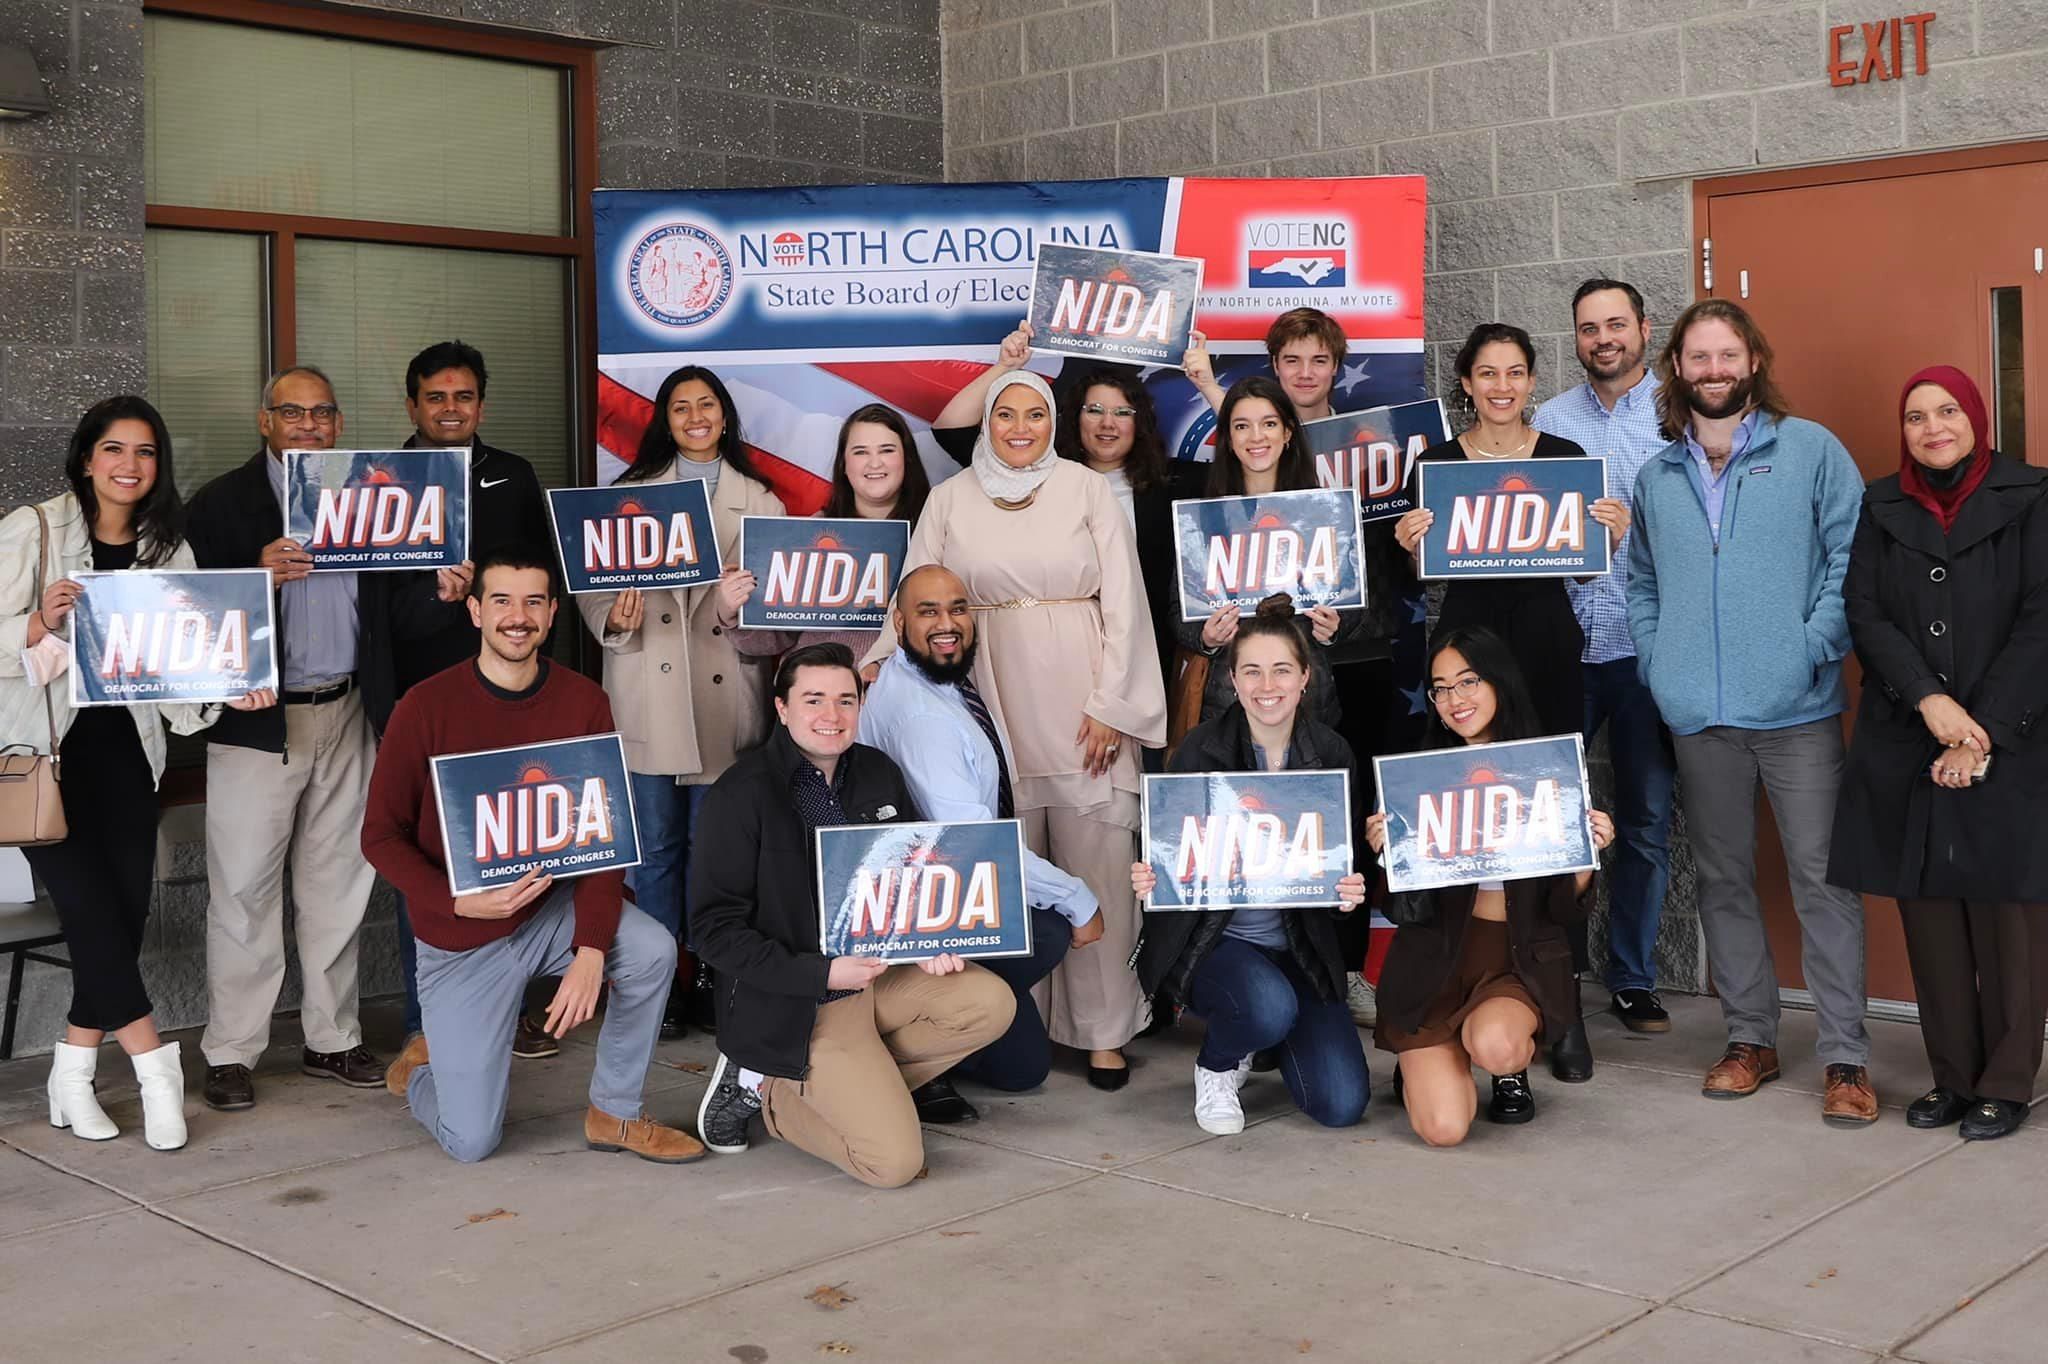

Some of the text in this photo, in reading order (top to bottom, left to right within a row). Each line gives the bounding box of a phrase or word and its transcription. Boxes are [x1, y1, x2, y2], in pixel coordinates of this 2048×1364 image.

[1827, 12, 1936, 87] EXIT
[665, 226, 697, 236] STATE
[704, 235, 729, 264] NORTH
[773, 244, 805, 255] VOTE
[767, 283, 835, 307] State
[846, 279, 928, 305] Board
[936, 279, 966, 309] of
[1050, 277, 1175, 344] NIDA
[1197, 295, 1398, 307] MY NORTH CAROLINA. MY VOTE.
[1050, 336, 1168, 358] DEMOCRAT FOR CONGRESS
[1315, 433, 1429, 498] NIDA
[312, 485, 444, 548] NIDA
[1372, 502, 1390, 511] FOR
[1446, 491, 1584, 554] NIDA
[314, 551, 444, 563] DEMOCRAT FOR CONGRESS
[583, 512, 699, 571] NIDA
[590, 569, 700, 584] DEMOCRAT FOR CONGRESS
[1206, 526, 1340, 595] NIDA
[1449, 557, 1584, 568] DEMOCRAT FOR CONGRESS
[764, 551, 889, 608] NIDA
[766, 611, 817, 620] DEMOCRAT
[819, 612, 838, 621] FOR
[102, 609, 248, 679] NIDA
[104, 680, 249, 694] DEMOCRAT FOR CONGRESS
[475, 777, 614, 863] NIDA
[1416, 778, 1565, 859] NIDA
[481, 849, 616, 879] DEMOCRAT FOR CONGRESS
[1175, 811, 1325, 883] NIDA
[1423, 860, 1483, 875] MOCRAT
[852, 860, 1000, 937] NIDA
[1180, 885, 1324, 897] DEMOCRAT FOR CONGRESS
[854, 935, 1001, 953] DEMOCRAT FOR CONGRESS
